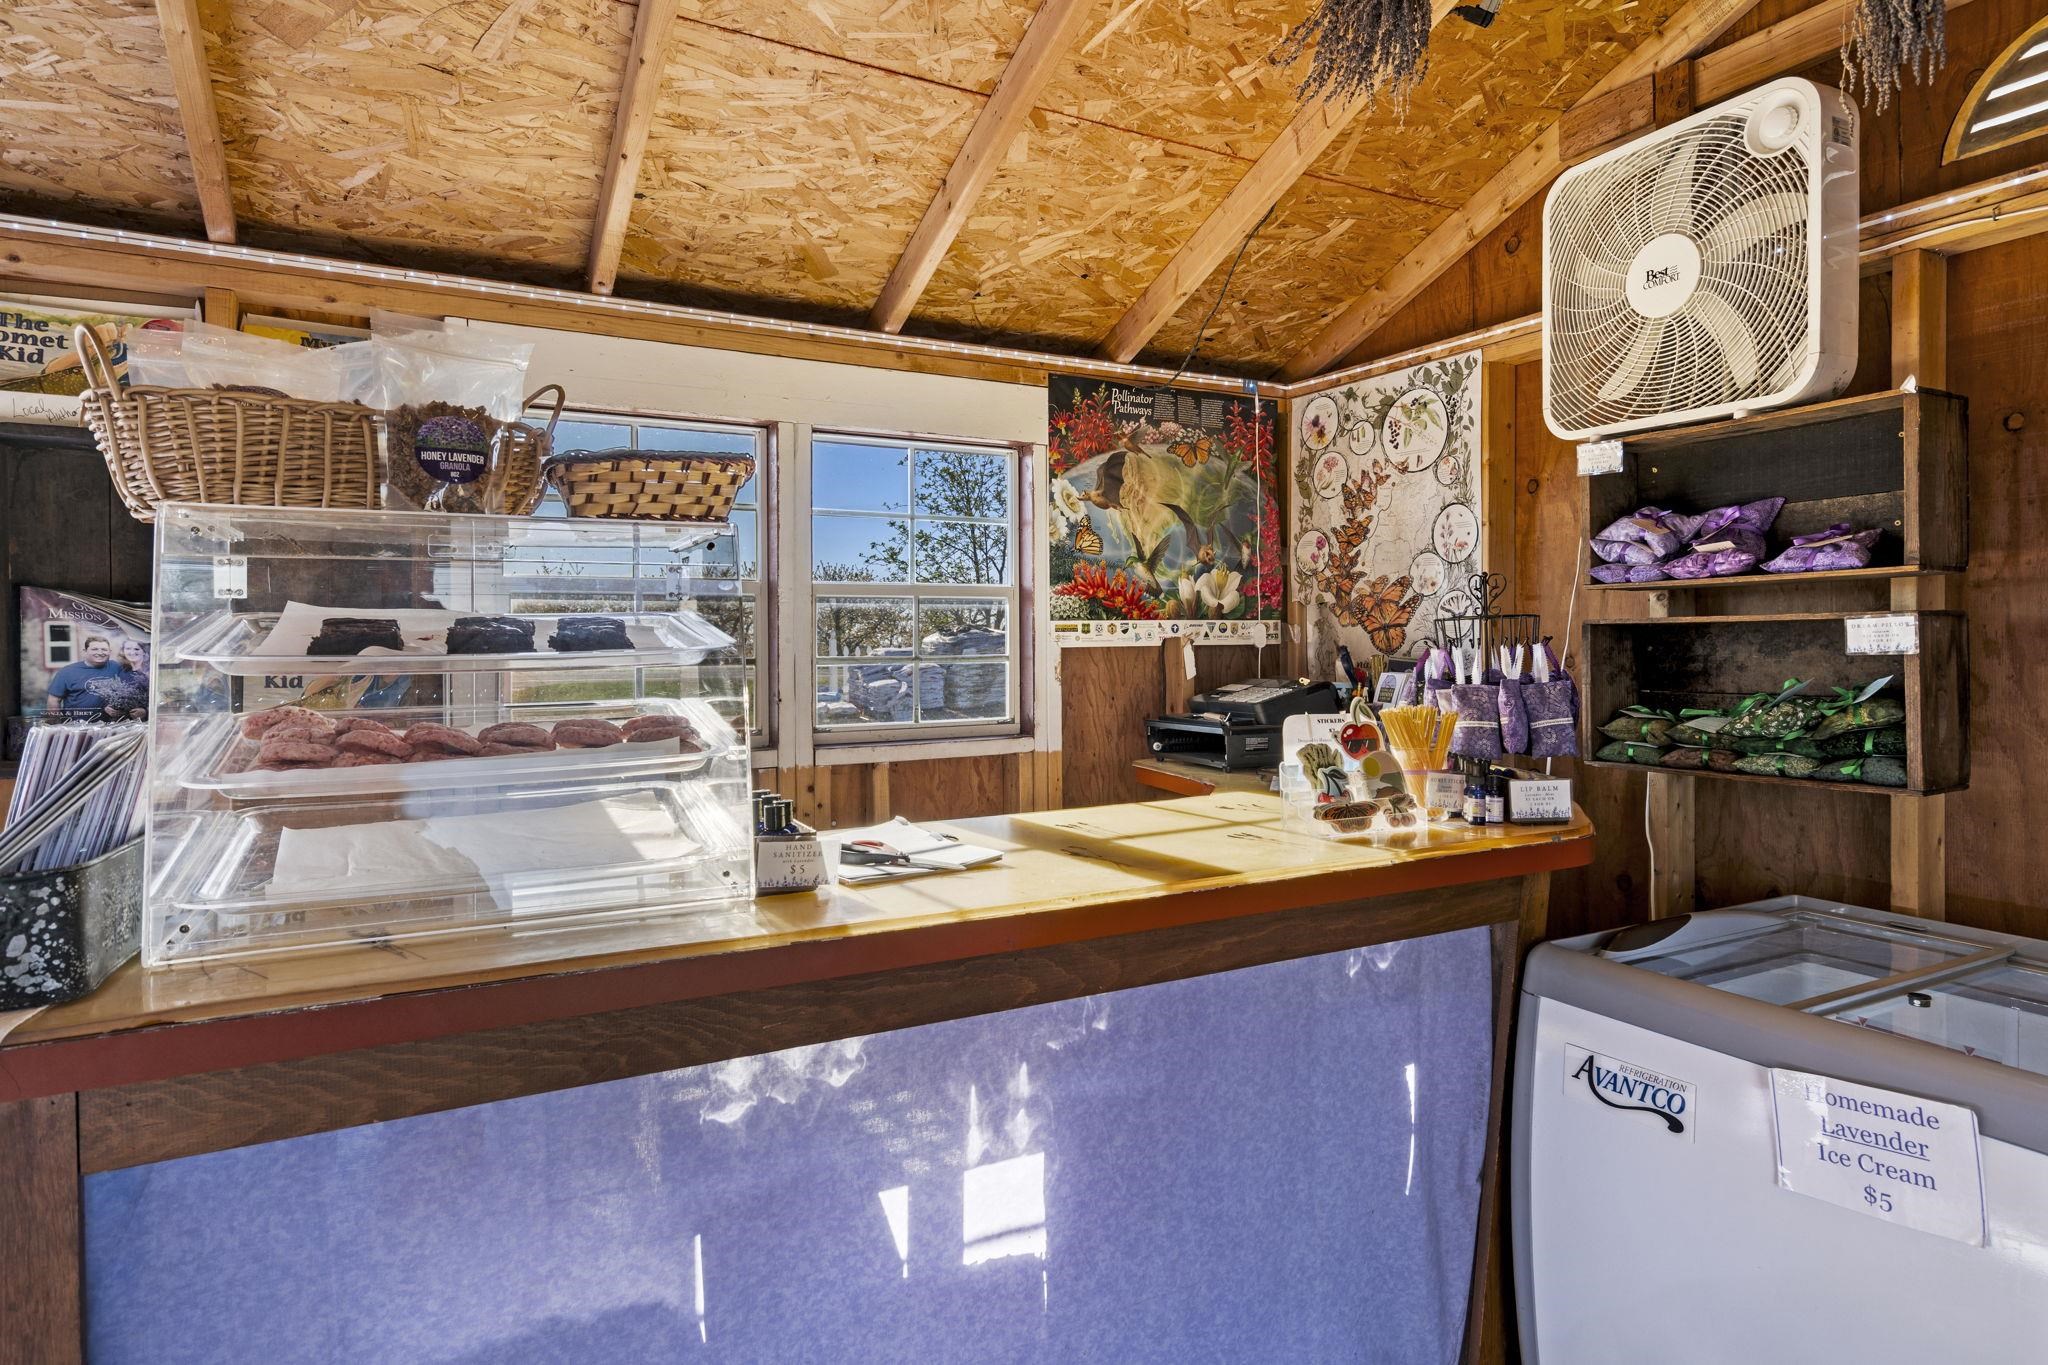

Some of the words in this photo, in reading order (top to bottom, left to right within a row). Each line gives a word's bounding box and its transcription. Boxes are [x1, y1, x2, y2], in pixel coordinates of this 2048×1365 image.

[1642, 271, 1681, 290] COMFORT
[1646, 267, 1669, 282] Best
[0, 312, 49, 331] The
[0, 345, 44, 364] Kid
[1111, 387, 1154, 404] Pollinator
[13, 398, 46, 418] Local
[1114, 400, 1152, 416] Pathways
[420, 451, 447, 461] HONEY
[448, 452, 485, 465] LAVENDER
[439, 462, 471, 472] GRANOLA
[264, 675, 303, 688] Kid
[773, 850, 824, 859] SANITIZER
[1571, 1054, 1686, 1116] AVANTCO
[1618, 1064, 1688, 1093] REFRIGERATION
[1821, 1115, 1930, 1158] Lavender
[1818, 1142, 1851, 1168] Ice
[1858, 1153, 1938, 1191] Cream
[1863, 1183, 1893, 1213] $5
